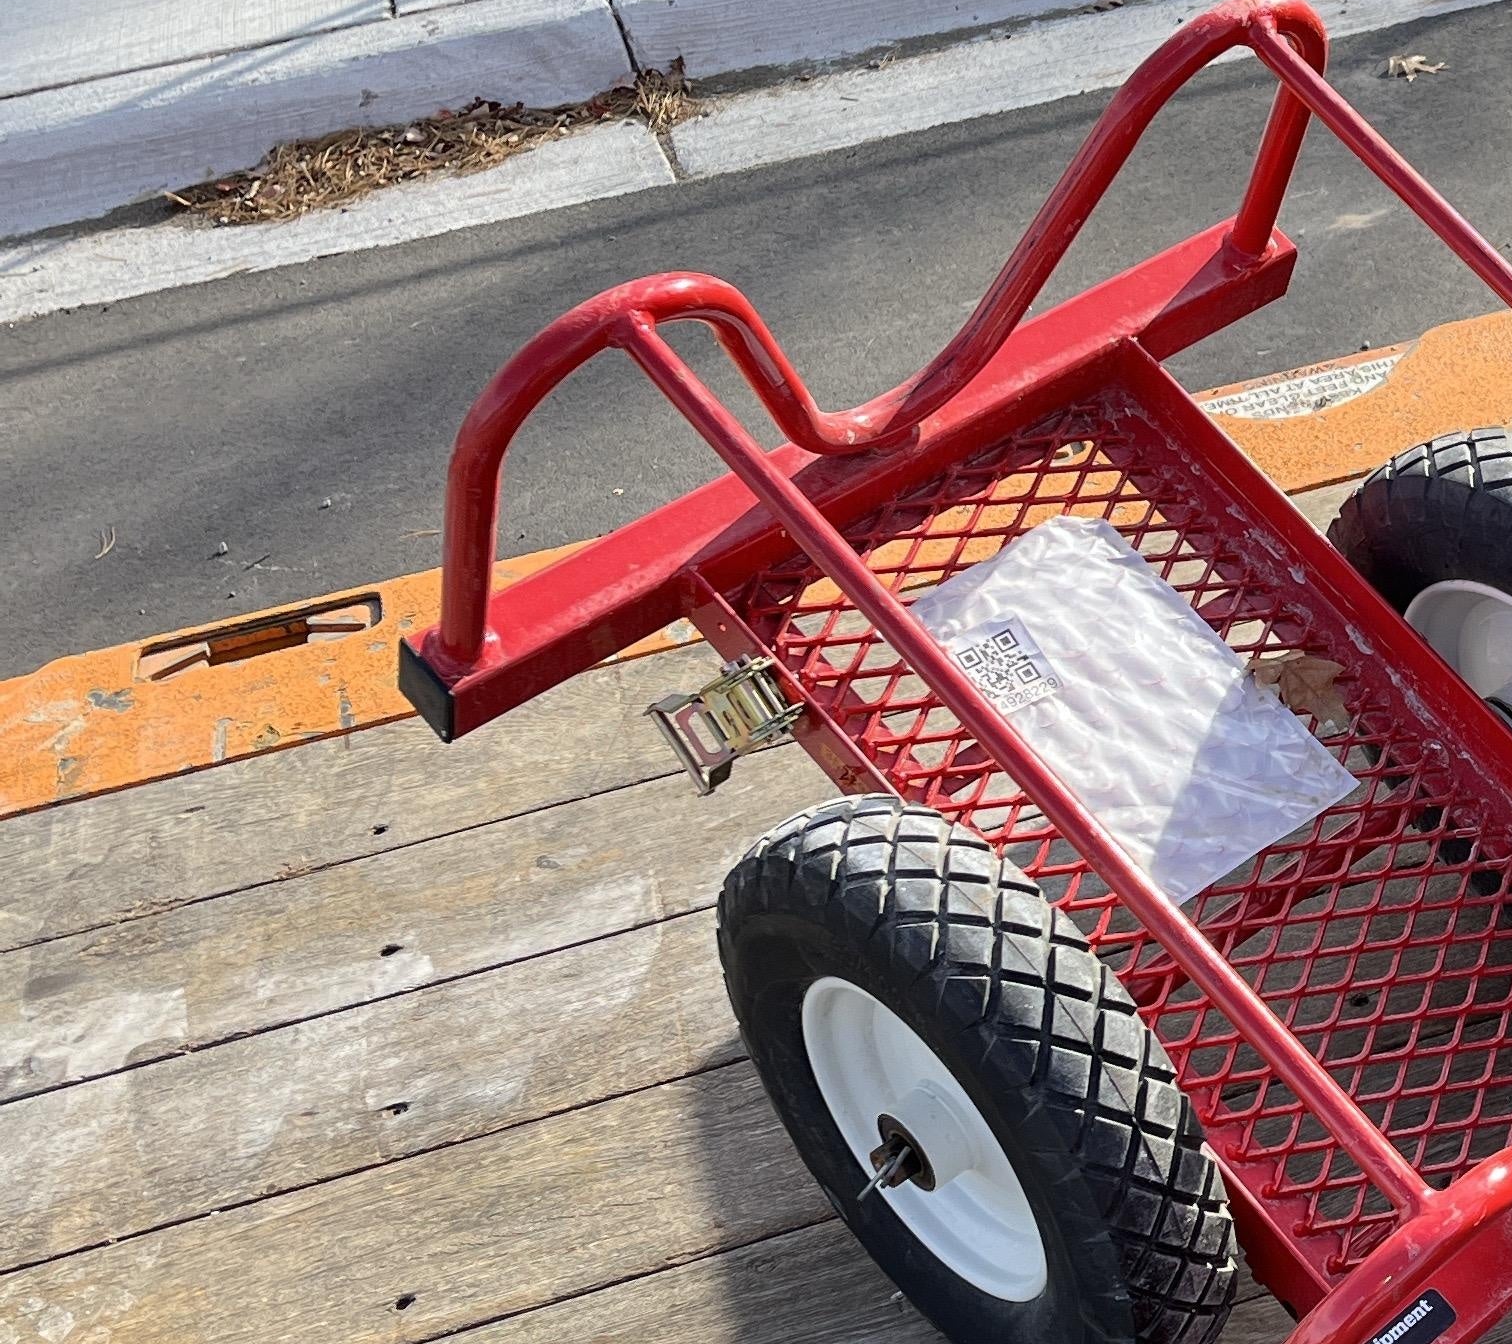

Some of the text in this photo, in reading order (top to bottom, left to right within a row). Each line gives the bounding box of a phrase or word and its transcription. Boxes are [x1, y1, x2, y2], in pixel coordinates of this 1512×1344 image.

[1310, 368, 1356, 385] AREA
[1355, 370, 1387, 385] AND
[1248, 387, 1280, 400] ALL
[1285, 379, 1305, 393] AT
[1304, 380, 1348, 396] FEET
[1242, 392, 1301, 412] CLEAR
